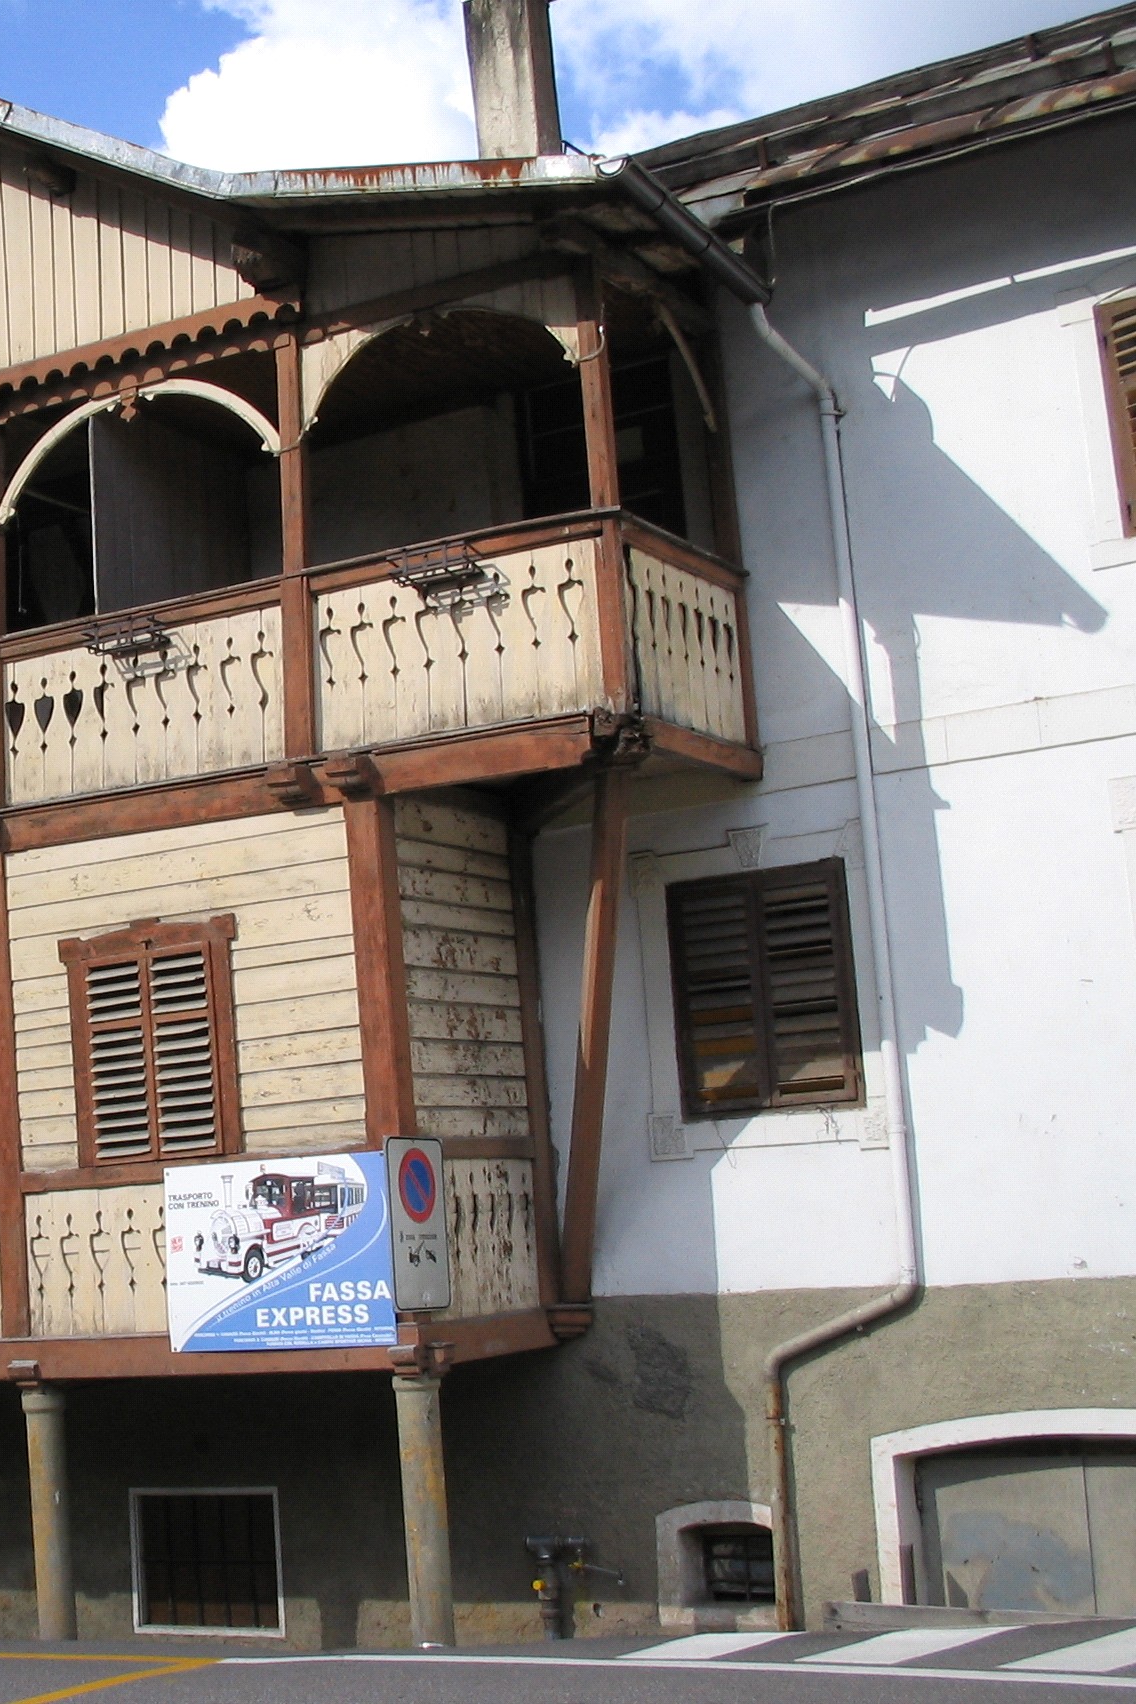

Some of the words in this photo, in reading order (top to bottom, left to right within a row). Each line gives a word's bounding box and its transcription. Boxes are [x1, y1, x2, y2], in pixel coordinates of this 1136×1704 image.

[168, 1192, 213, 1201] TRASPORTO
[168, 1202, 184, 1210] CON
[187, 1200, 219, 1209] TRENINO
[262, 1278, 280, 1291] Alta
[311, 1243, 336, 1264] Fassa
[309, 1280, 391, 1302] FASSA
[256, 1304, 369, 1327] EXPRESS
